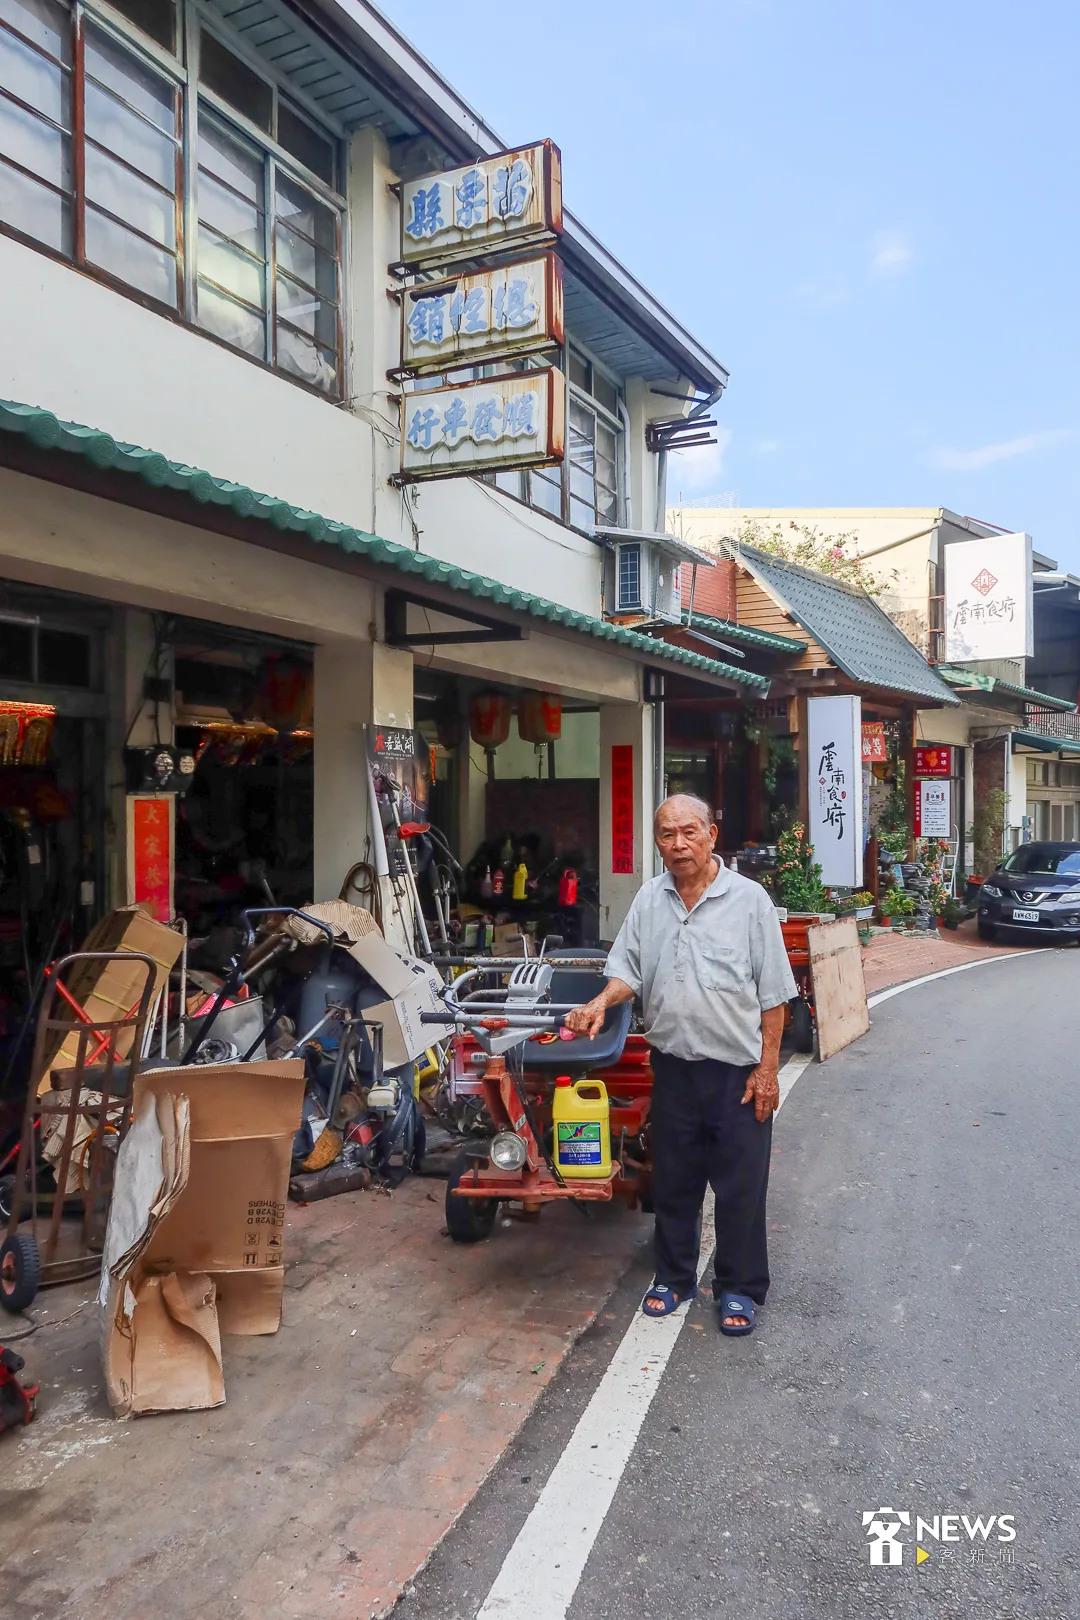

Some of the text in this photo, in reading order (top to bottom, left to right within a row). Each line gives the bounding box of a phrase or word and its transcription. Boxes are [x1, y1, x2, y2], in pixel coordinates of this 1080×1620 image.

[407, 393, 534, 447] 順發車行
[953, 596, 1016, 629] 雲南食府
[818, 741, 847, 840] 雲南食府
[248, 1200, 278, 1209] OTHERS
